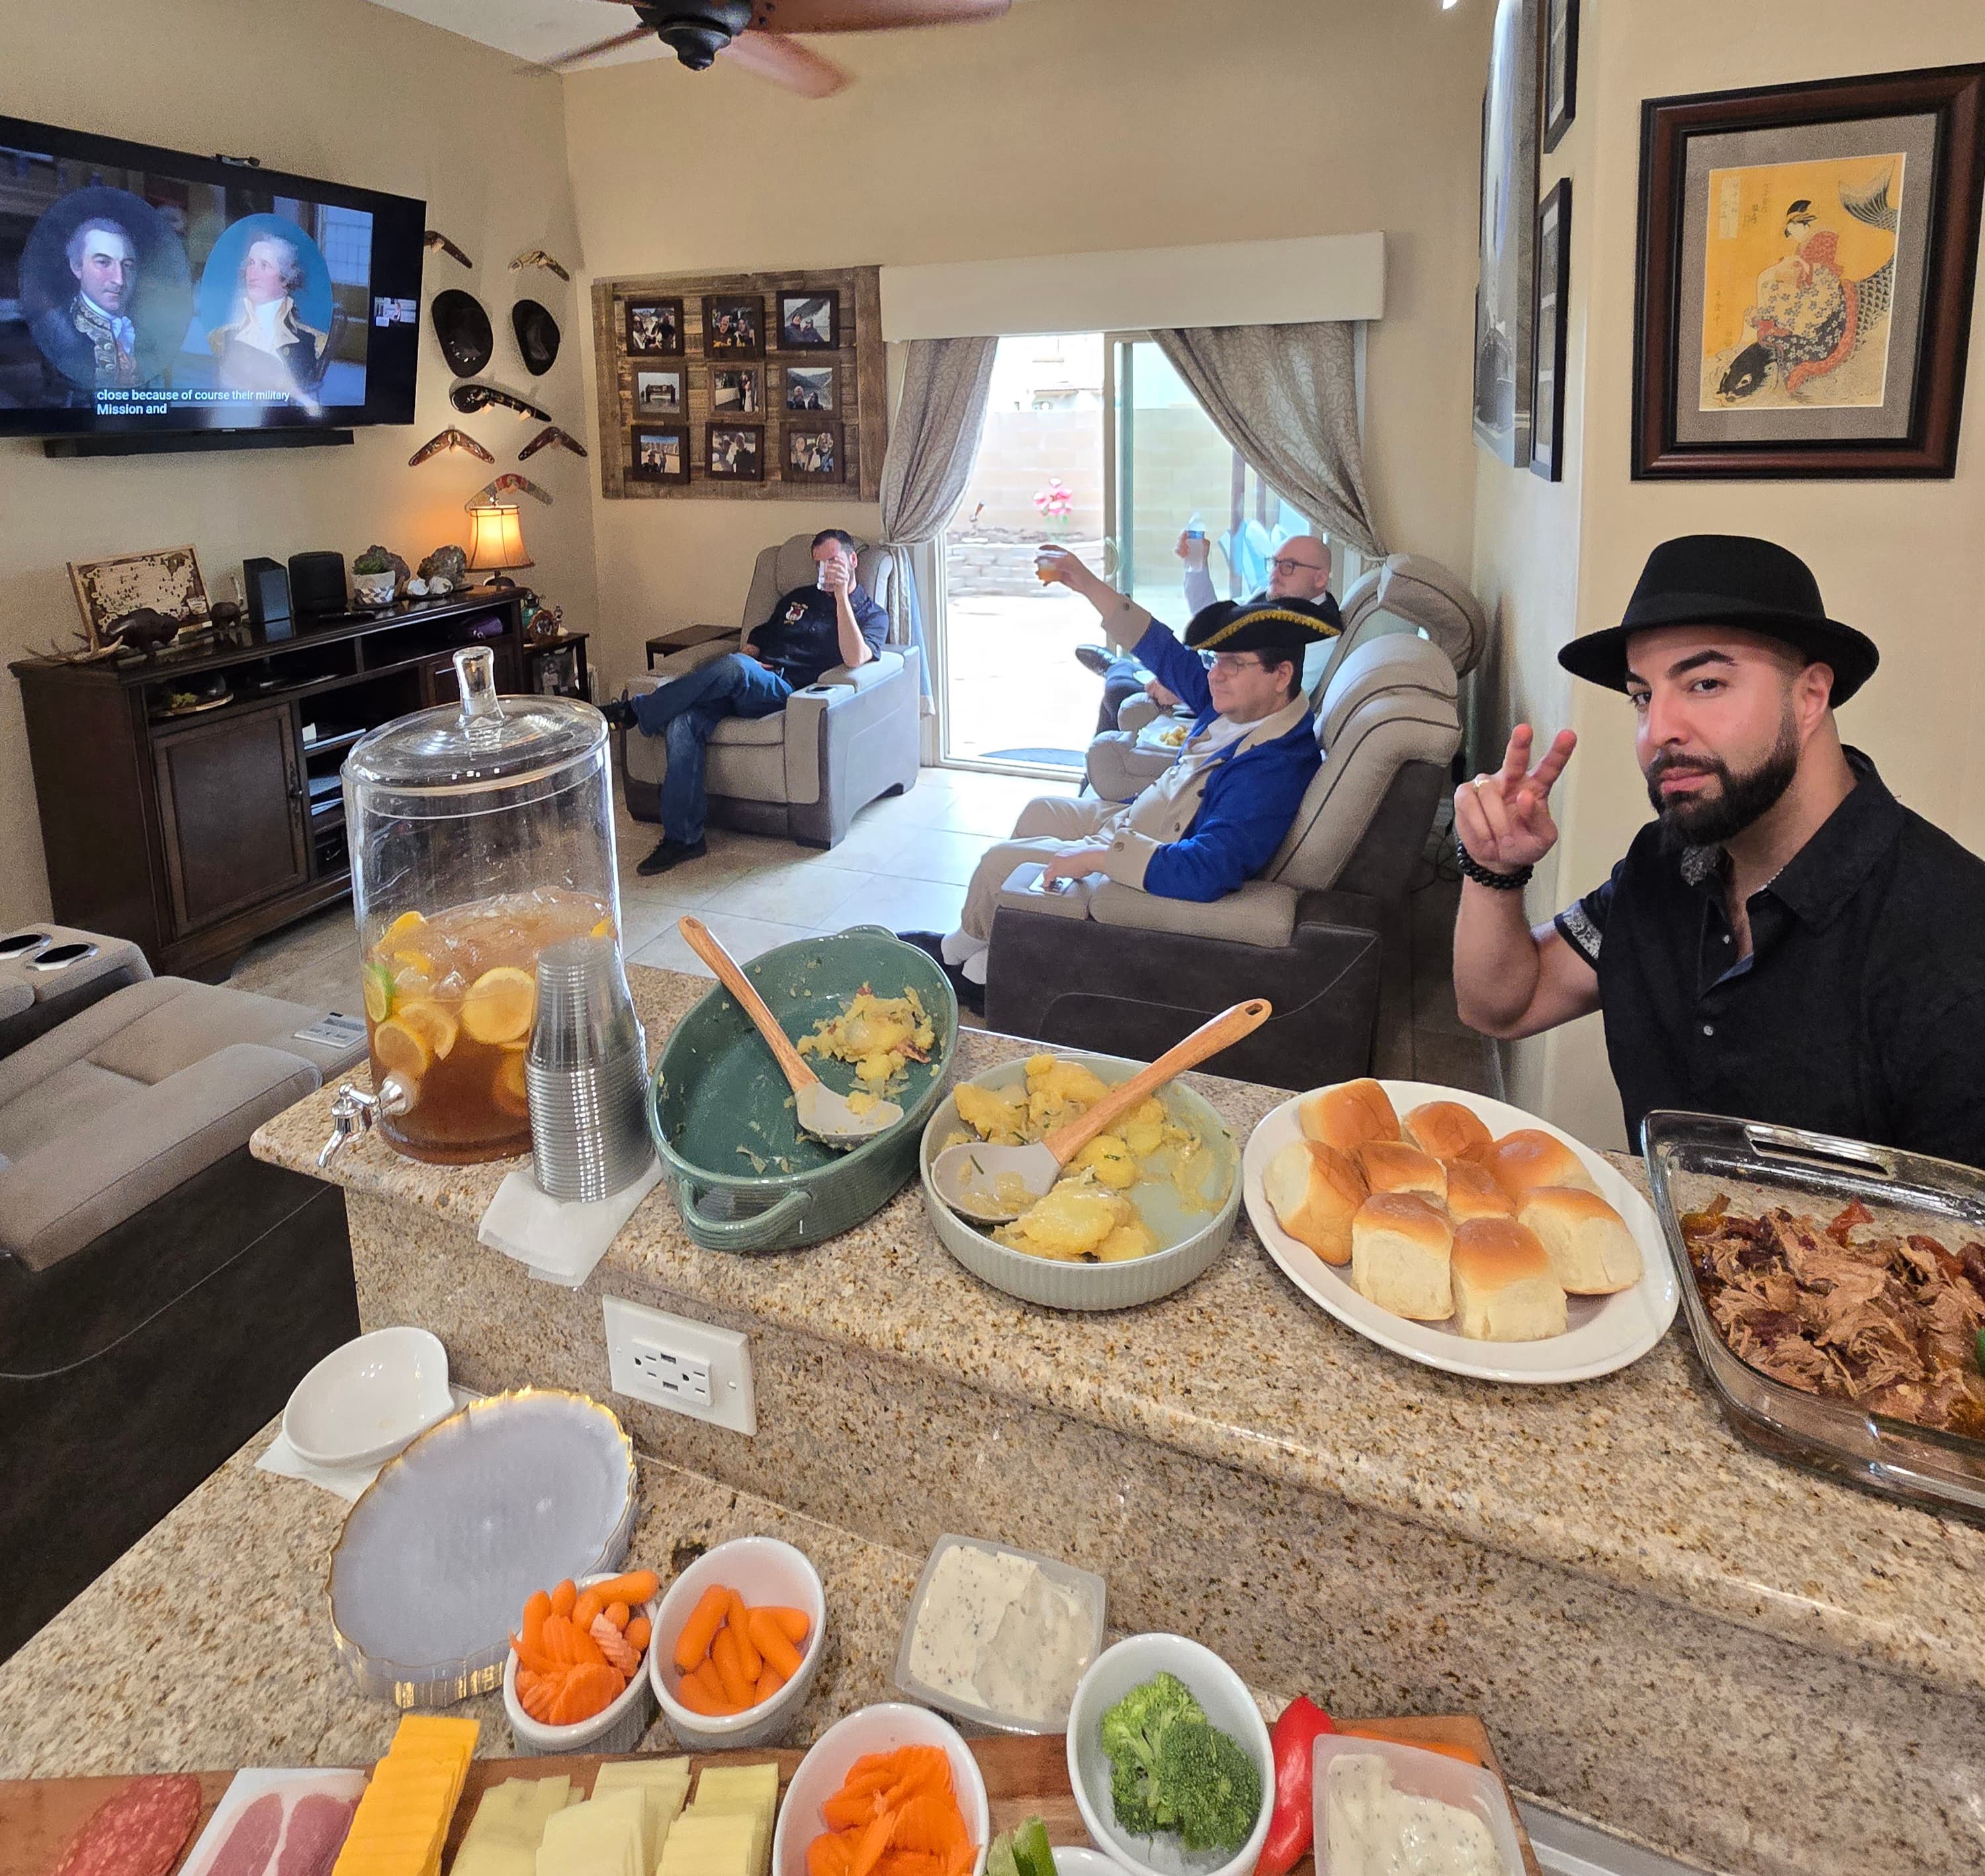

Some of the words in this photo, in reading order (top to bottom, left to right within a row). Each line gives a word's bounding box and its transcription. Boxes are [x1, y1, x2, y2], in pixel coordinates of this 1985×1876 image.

[97, 389, 129, 400] close
[132, 389, 179, 400] because
[181, 390, 193, 400] of
[232, 390, 253, 400] their
[256, 390, 289, 402] military
[97, 404, 143, 415] Mission
[146, 403, 167, 414] and
